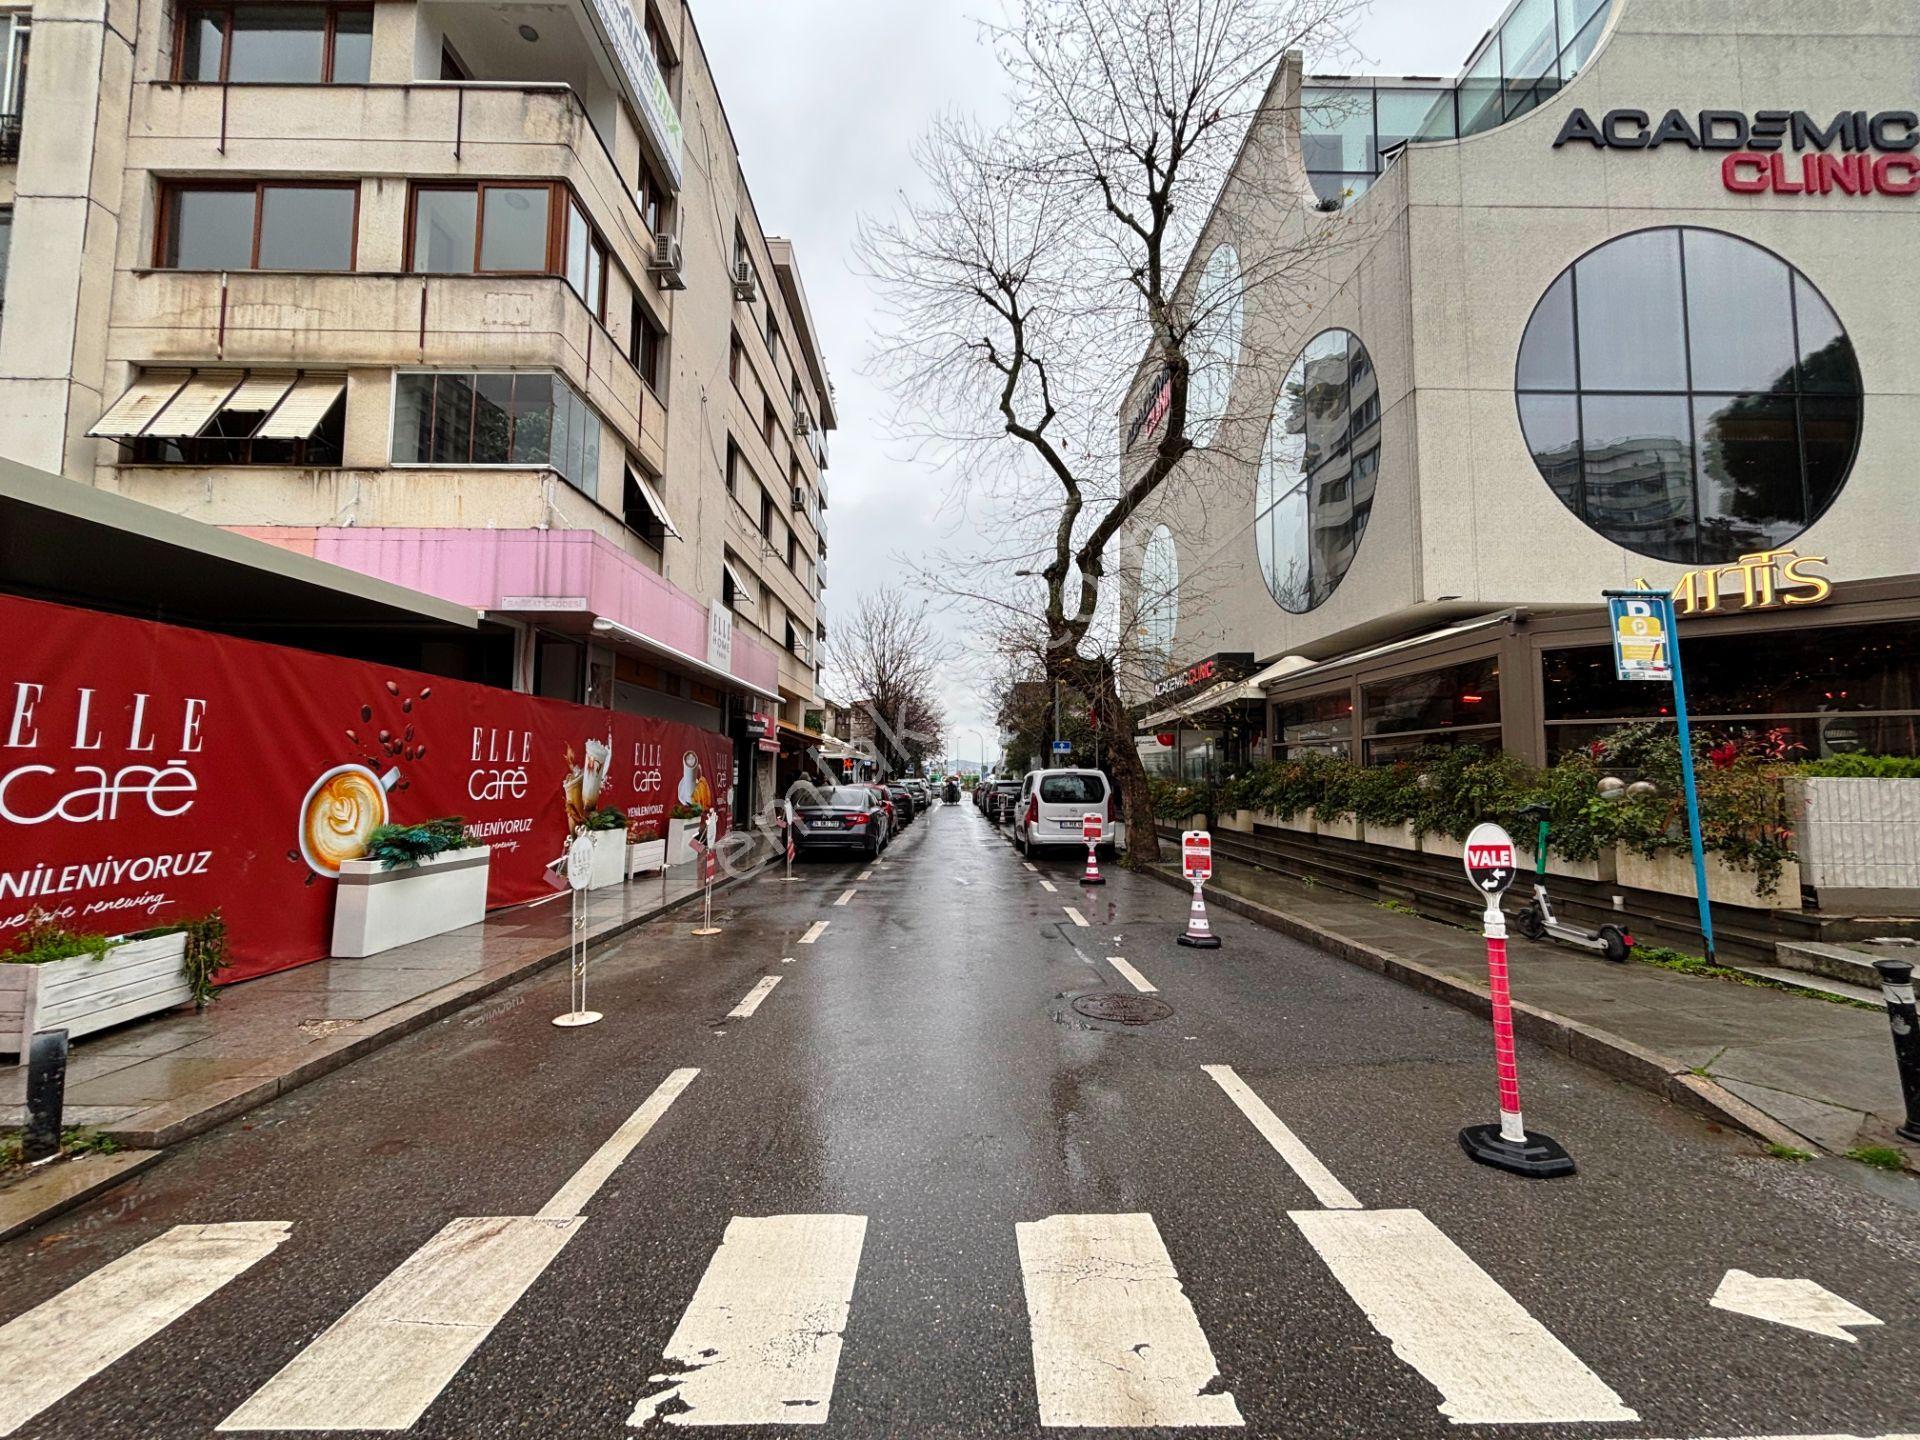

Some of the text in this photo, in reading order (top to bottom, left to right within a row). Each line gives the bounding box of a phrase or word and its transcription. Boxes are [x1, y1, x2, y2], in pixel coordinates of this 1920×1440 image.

[1553, 108, 1920, 150] ACADEMIC
[1722, 152, 1920, 196] CLINIC
[1187, 661, 1214, 686] CLINIC
[3, 682, 207, 752] ELLE
[470, 727, 532, 763] ELLE
[634, 743, 661, 767] ELLE
[1468, 850, 1511, 867] VALE
[82, 890, 176, 915] renewing
